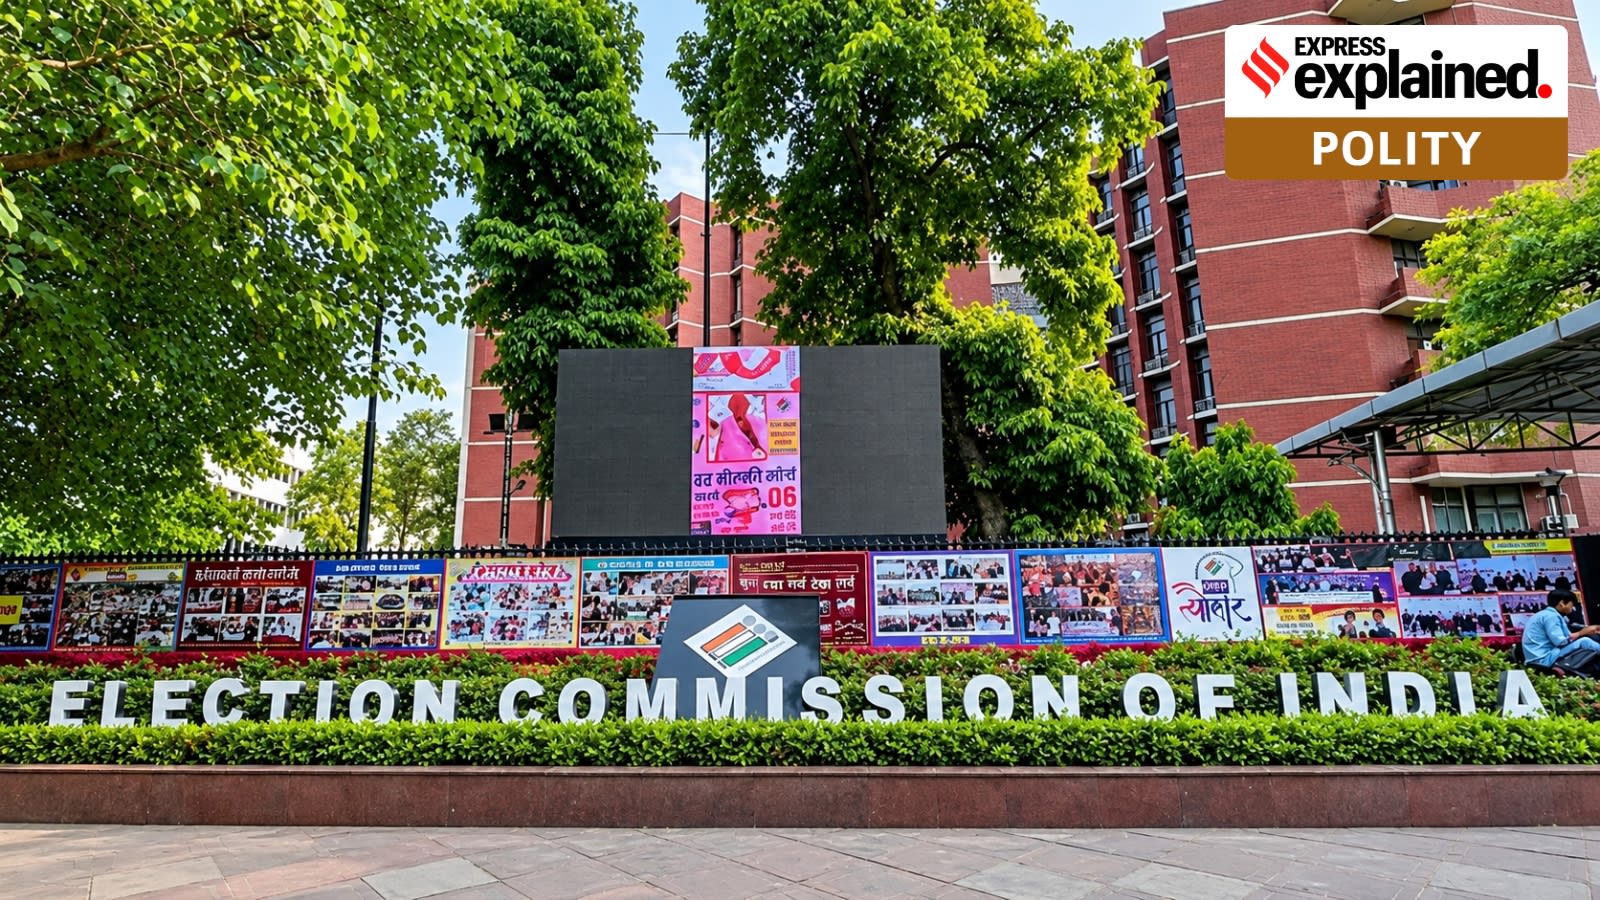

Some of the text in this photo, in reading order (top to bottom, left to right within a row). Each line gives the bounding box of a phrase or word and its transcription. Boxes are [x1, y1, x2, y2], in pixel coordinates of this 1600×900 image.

[768, 485, 797, 508] 06
[48, 669, 1550, 728] ELECTION COMMISSION OF INDIA
